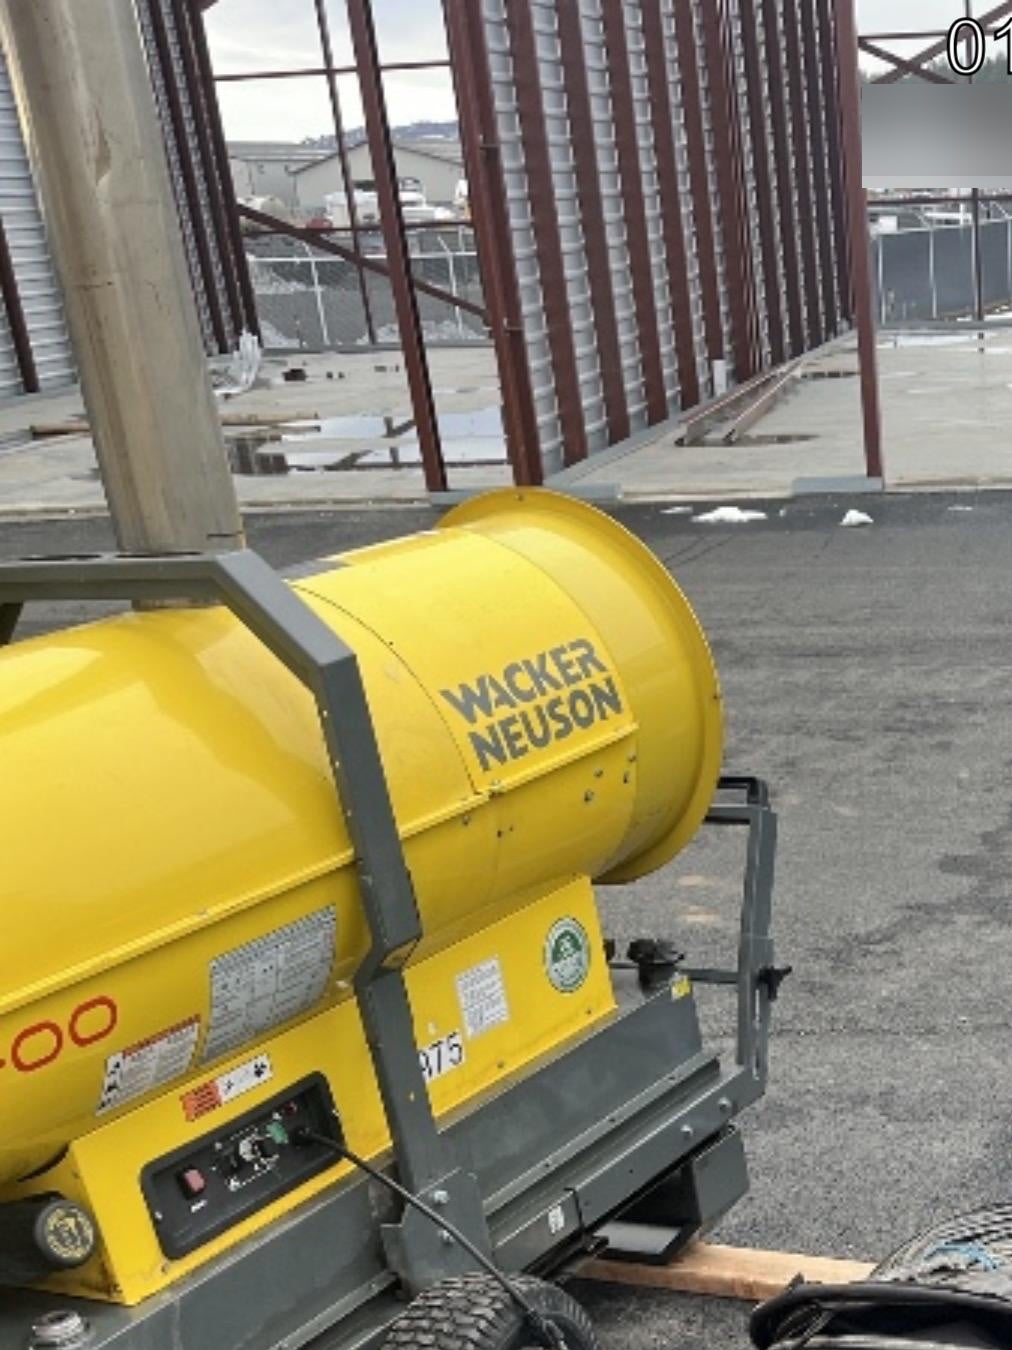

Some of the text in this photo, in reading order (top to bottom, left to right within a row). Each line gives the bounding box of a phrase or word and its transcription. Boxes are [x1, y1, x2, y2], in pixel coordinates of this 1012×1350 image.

[439, 638, 608, 724] WACKER
[468, 676, 624, 772] NEUSON
[0, 996, 117, 1072] 00
